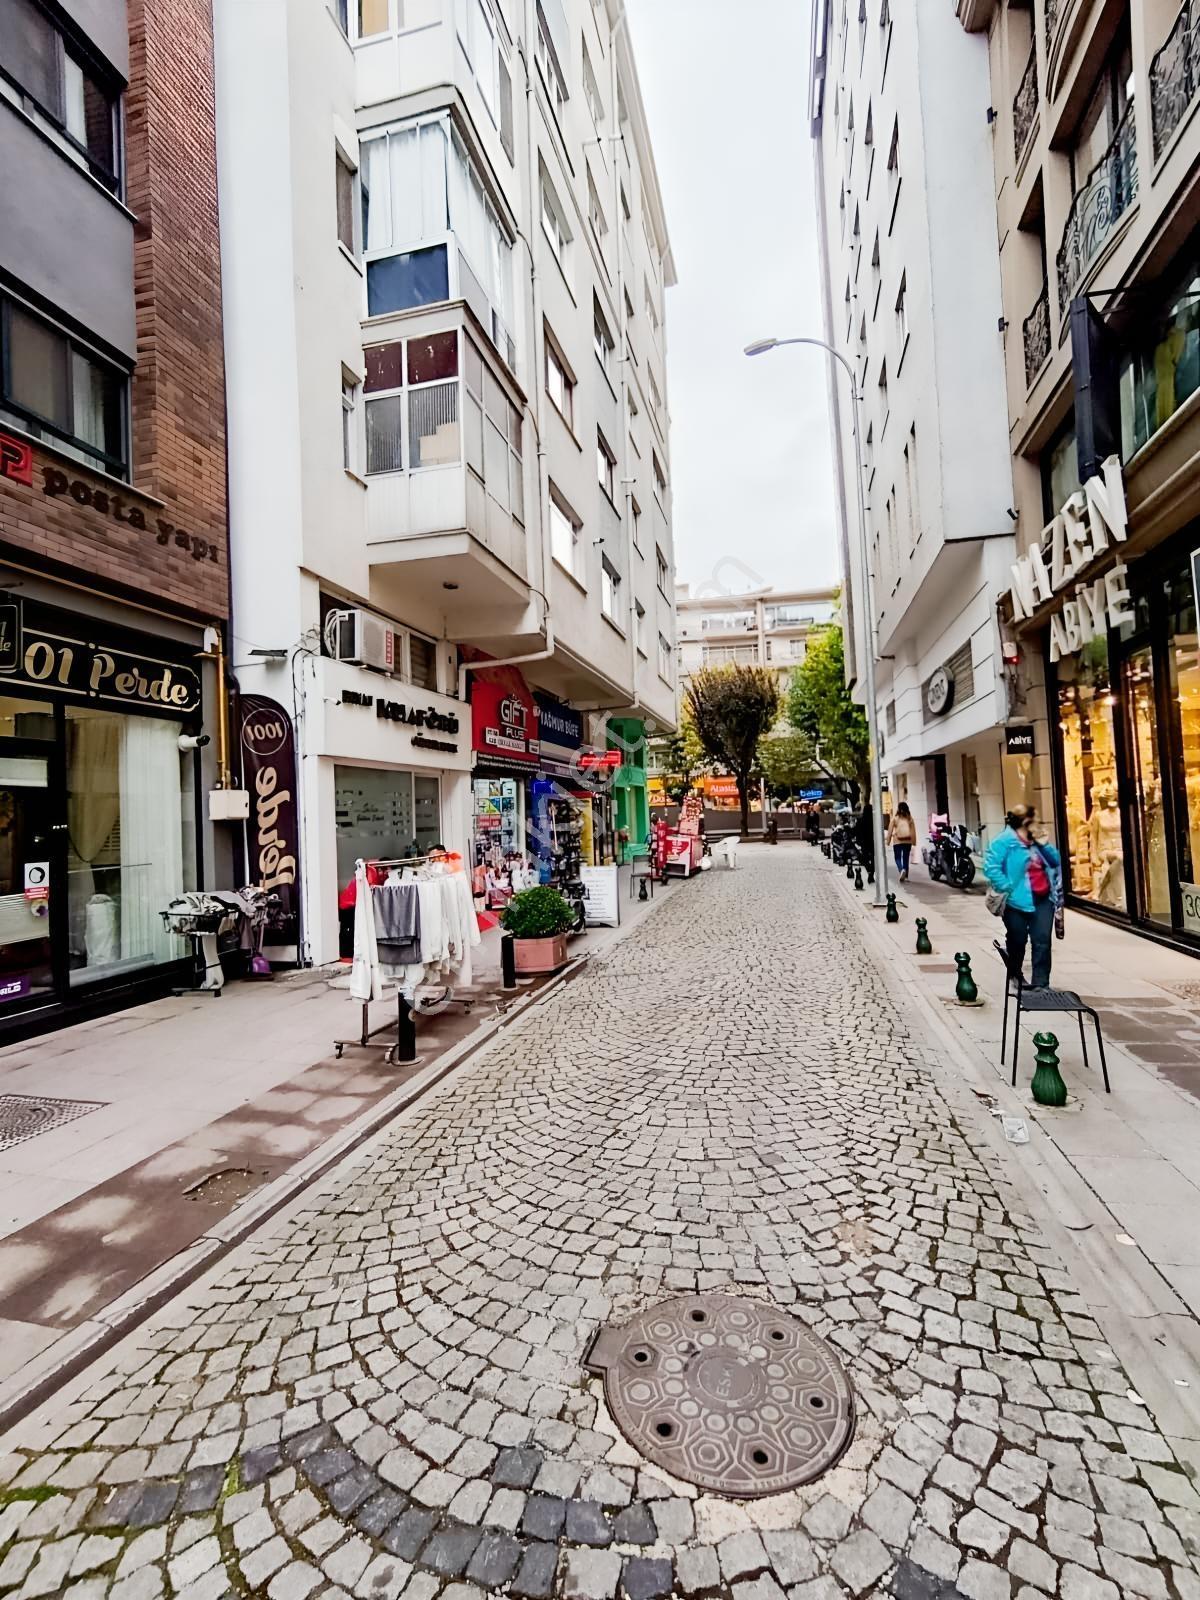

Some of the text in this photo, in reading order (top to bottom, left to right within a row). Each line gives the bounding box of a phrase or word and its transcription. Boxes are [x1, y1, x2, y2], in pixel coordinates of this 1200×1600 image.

[40, 466, 147, 530] posta
[1009, 453, 1129, 623] NAZEN
[1049, 563, 1136, 663] ABİYE
[89, 653, 189, 705] Perde
[1008, 735, 1032, 745] ABİYE
